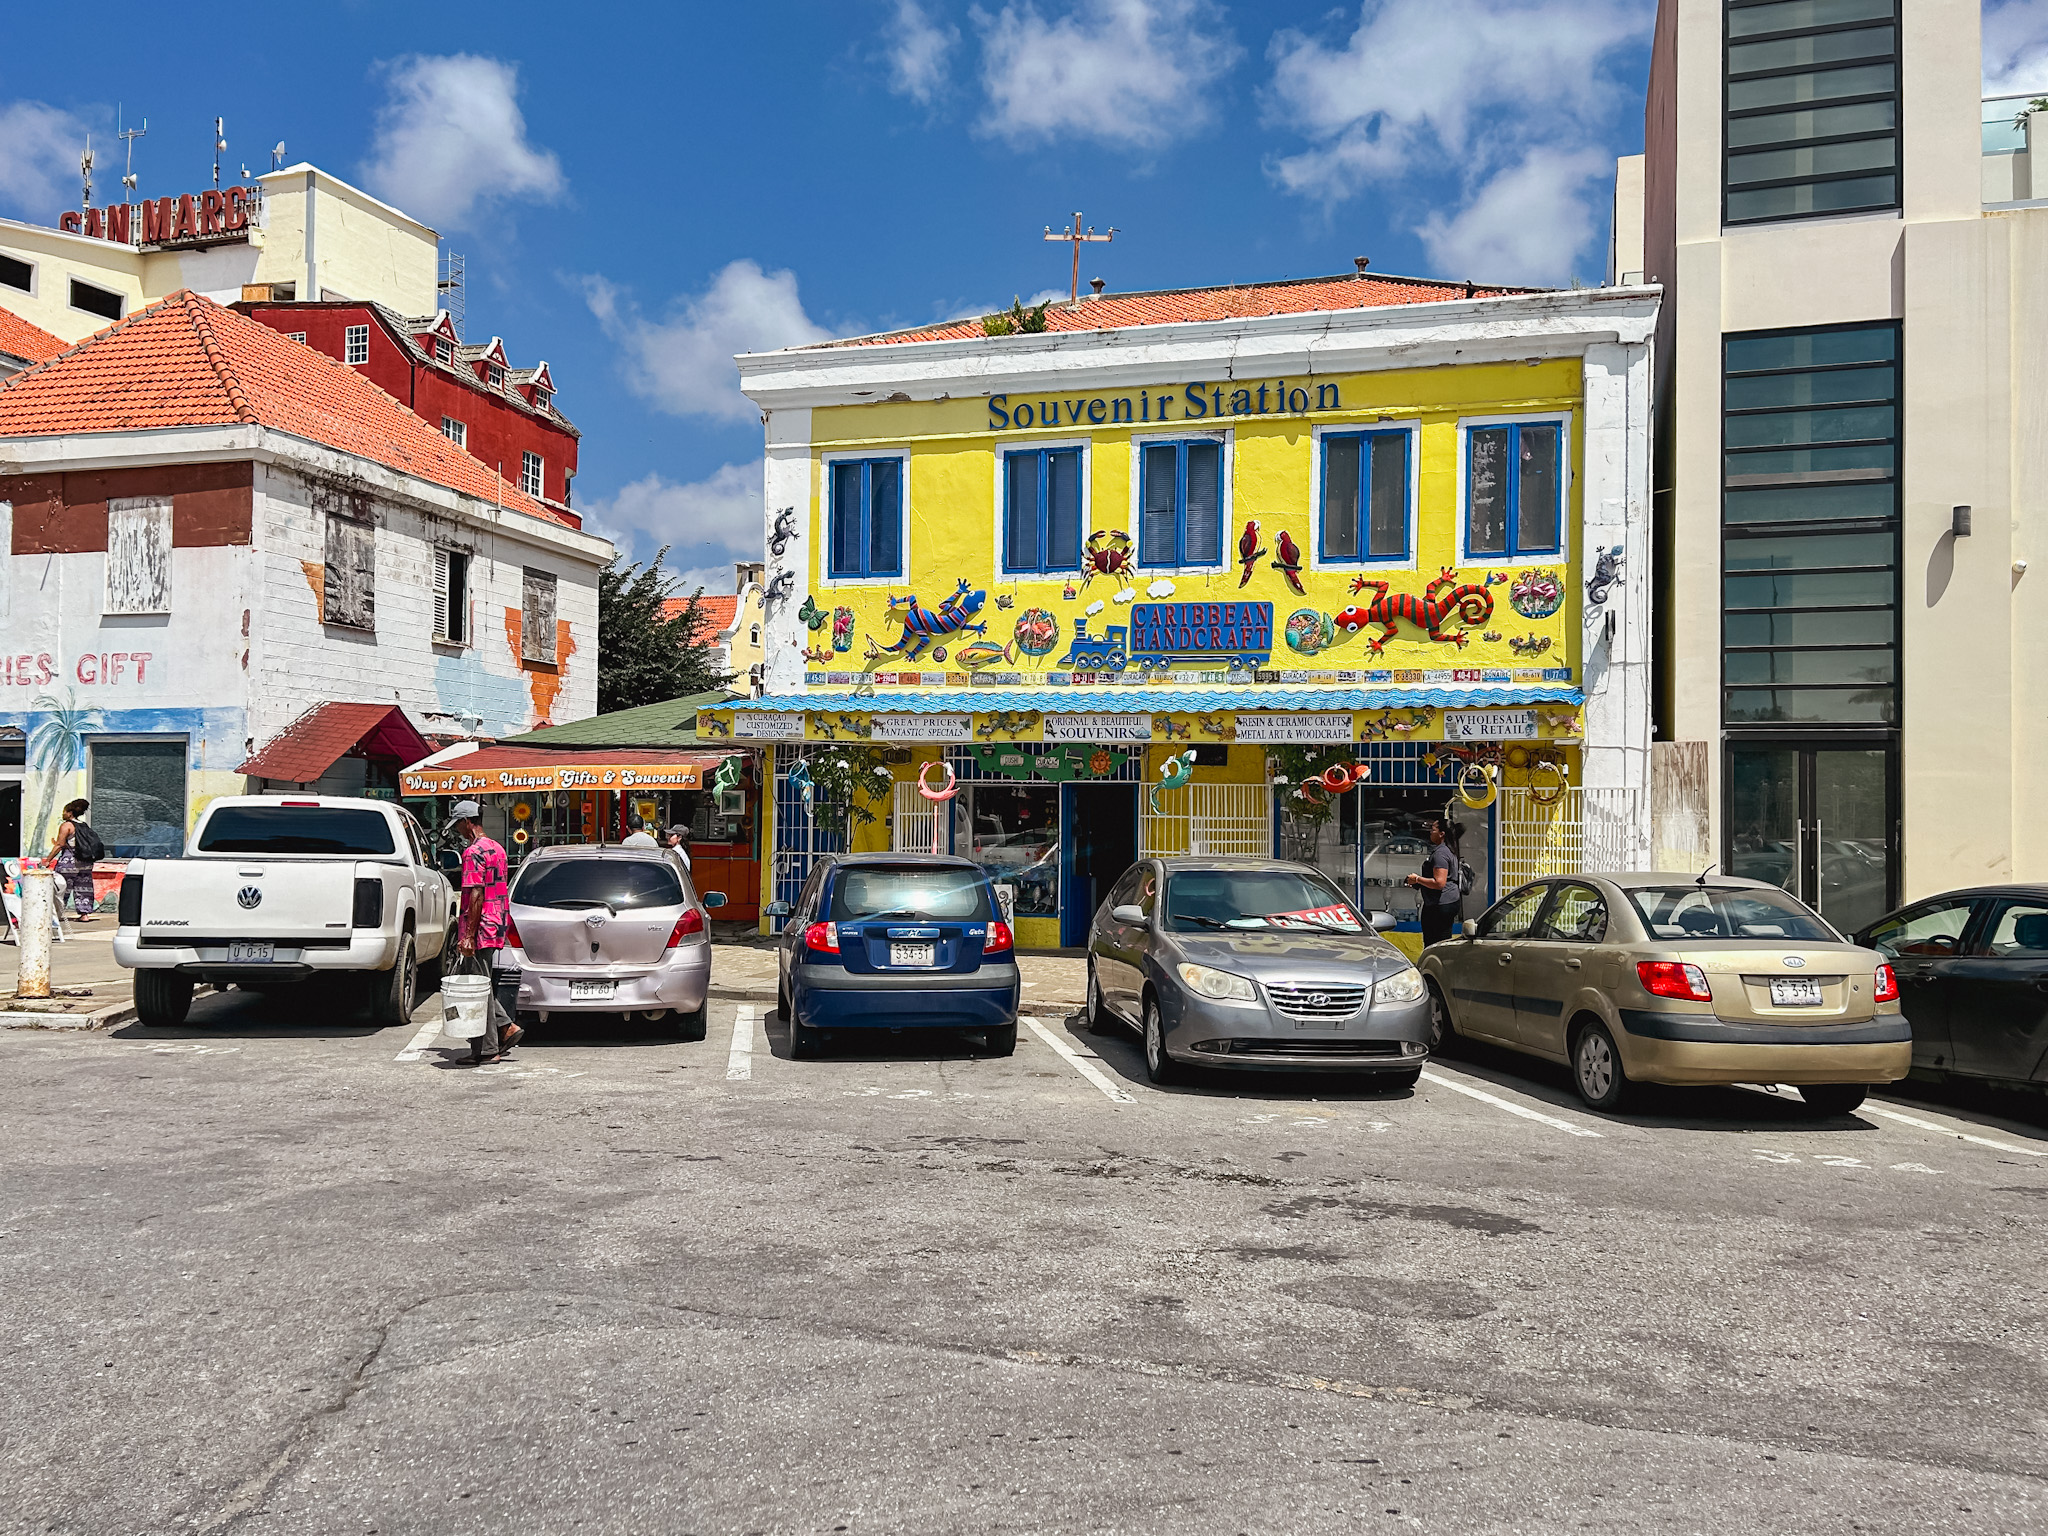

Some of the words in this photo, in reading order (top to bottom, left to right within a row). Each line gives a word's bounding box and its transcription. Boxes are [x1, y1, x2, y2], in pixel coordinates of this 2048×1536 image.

[60, 203, 130, 244] SAN
[142, 186, 247, 243] MARC
[988, 390, 1174, 430] Souvenir
[1185, 380, 1342, 419] Station
[1134, 604, 1269, 627] CARIBBEAN
[1133, 627, 1269, 649] HANDCRAFT
[0, 652, 52, 686] IES
[77, 652, 152, 685] GIFT
[886, 718, 919, 726] GREAT
[923, 718, 957, 726] PRICES
[1051, 717, 1088, 726] ORIGINAL
[1092, 717, 1097, 725] &
[1101, 716, 1143, 726] BEAUTIFUL
[1242, 717, 1265, 727] RESIN
[1267, 717, 1273, 727] &
[1276, 717, 1313, 726] CERAMIC
[1314, 716, 1345, 726] CRAFTS
[1454, 714, 1528, 724] WHOLESALE
[746, 721, 793, 730] CUSTOMIZED
[1461, 725, 1473, 735] &
[1480, 725, 1525, 734] RETAIL
[756, 730, 785, 738] DESIGNS
[880, 728, 924, 736] FANTASTIC
[927, 728, 963, 737] SPECIALS
[1060, 727, 1135, 739] SOUVENIRS
[1240, 729, 1267, 739] METAL
[1269, 730, 1285, 739] ART
[1286, 729, 1293, 739] &
[1295, 729, 1347, 739] WOODCRAFT
[405, 775, 438, 793] Way
[441, 776, 455, 790] of
[458, 774, 486, 791] Art
[499, 772, 553, 788] Unique
[559, 769, 598, 788] Gifts
[602, 770, 616, 784] &
[620, 769, 697, 786] Souvenirs
[1305, 907, 1356, 925] SALE
